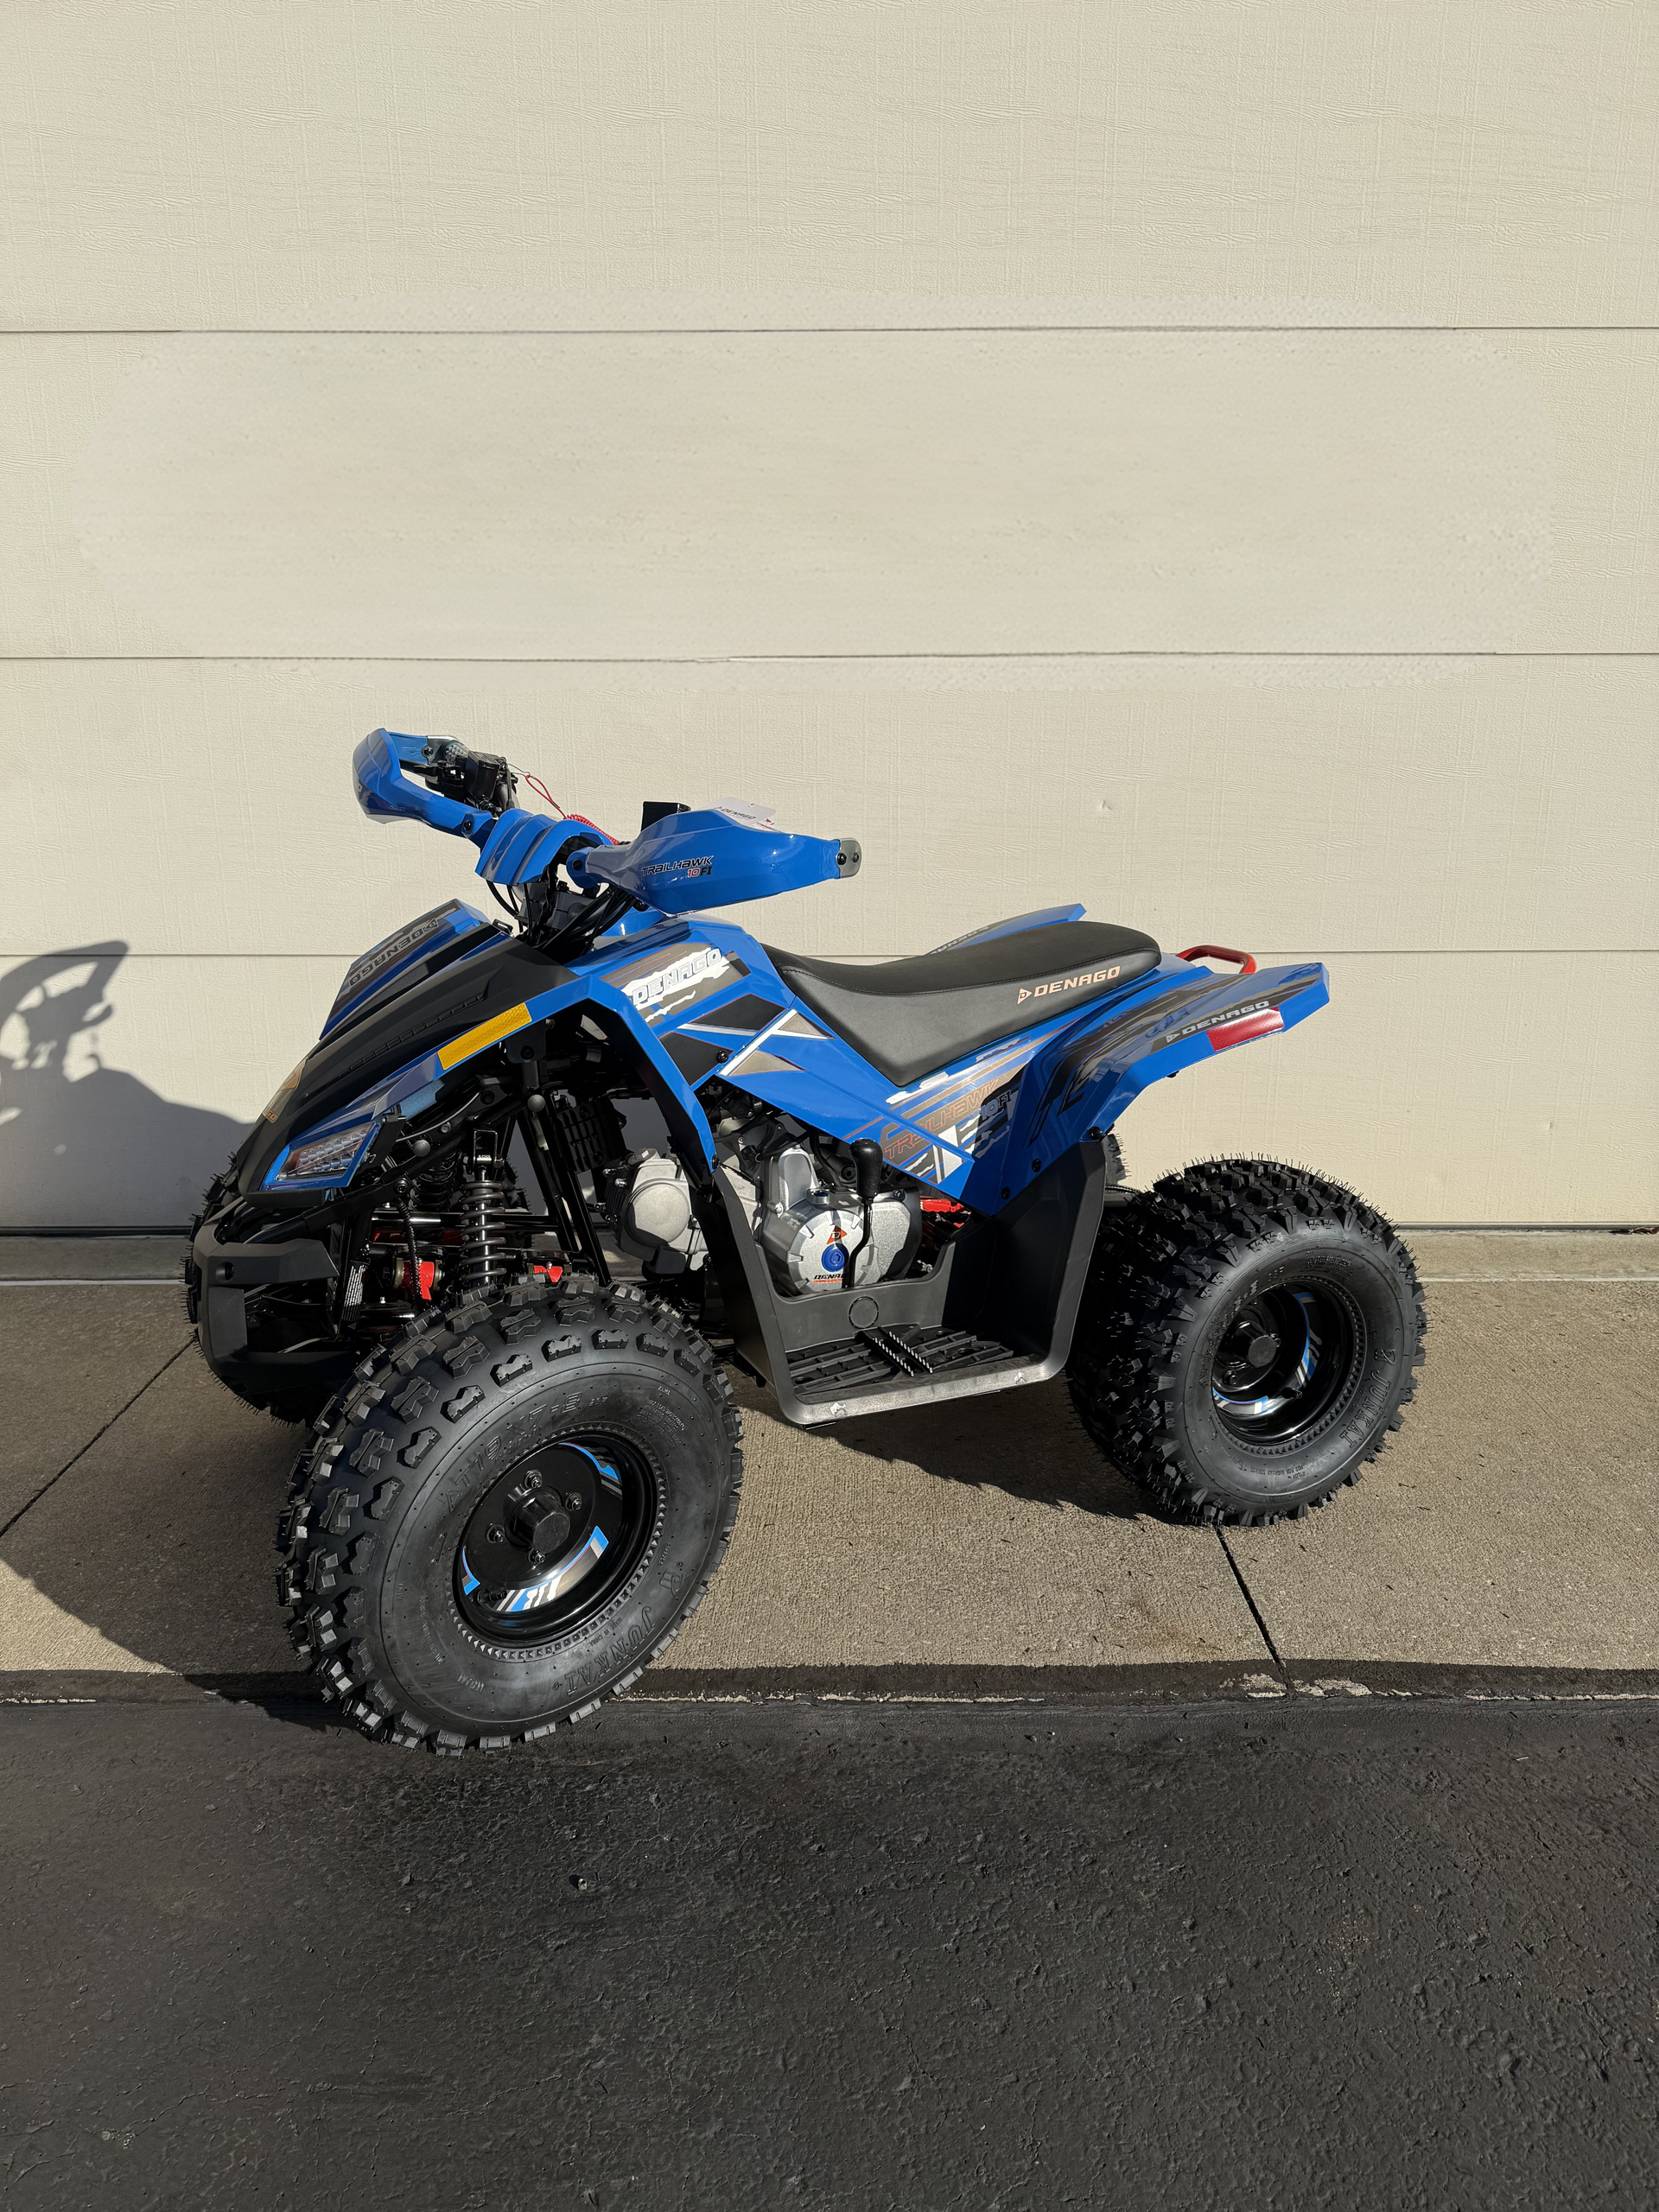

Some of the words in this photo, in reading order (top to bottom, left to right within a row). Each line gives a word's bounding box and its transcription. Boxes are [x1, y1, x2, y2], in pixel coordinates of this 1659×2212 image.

[349, 927, 424, 986] DENAGO
[632, 947, 722, 1006] DENAGO
[1034, 965, 1121, 998] DENAGO
[1182, 1001, 1269, 1035] DENAGO
[1339, 1370, 1391, 1449] JUNKAI
[564, 1605, 656, 1695] JUNKAI
